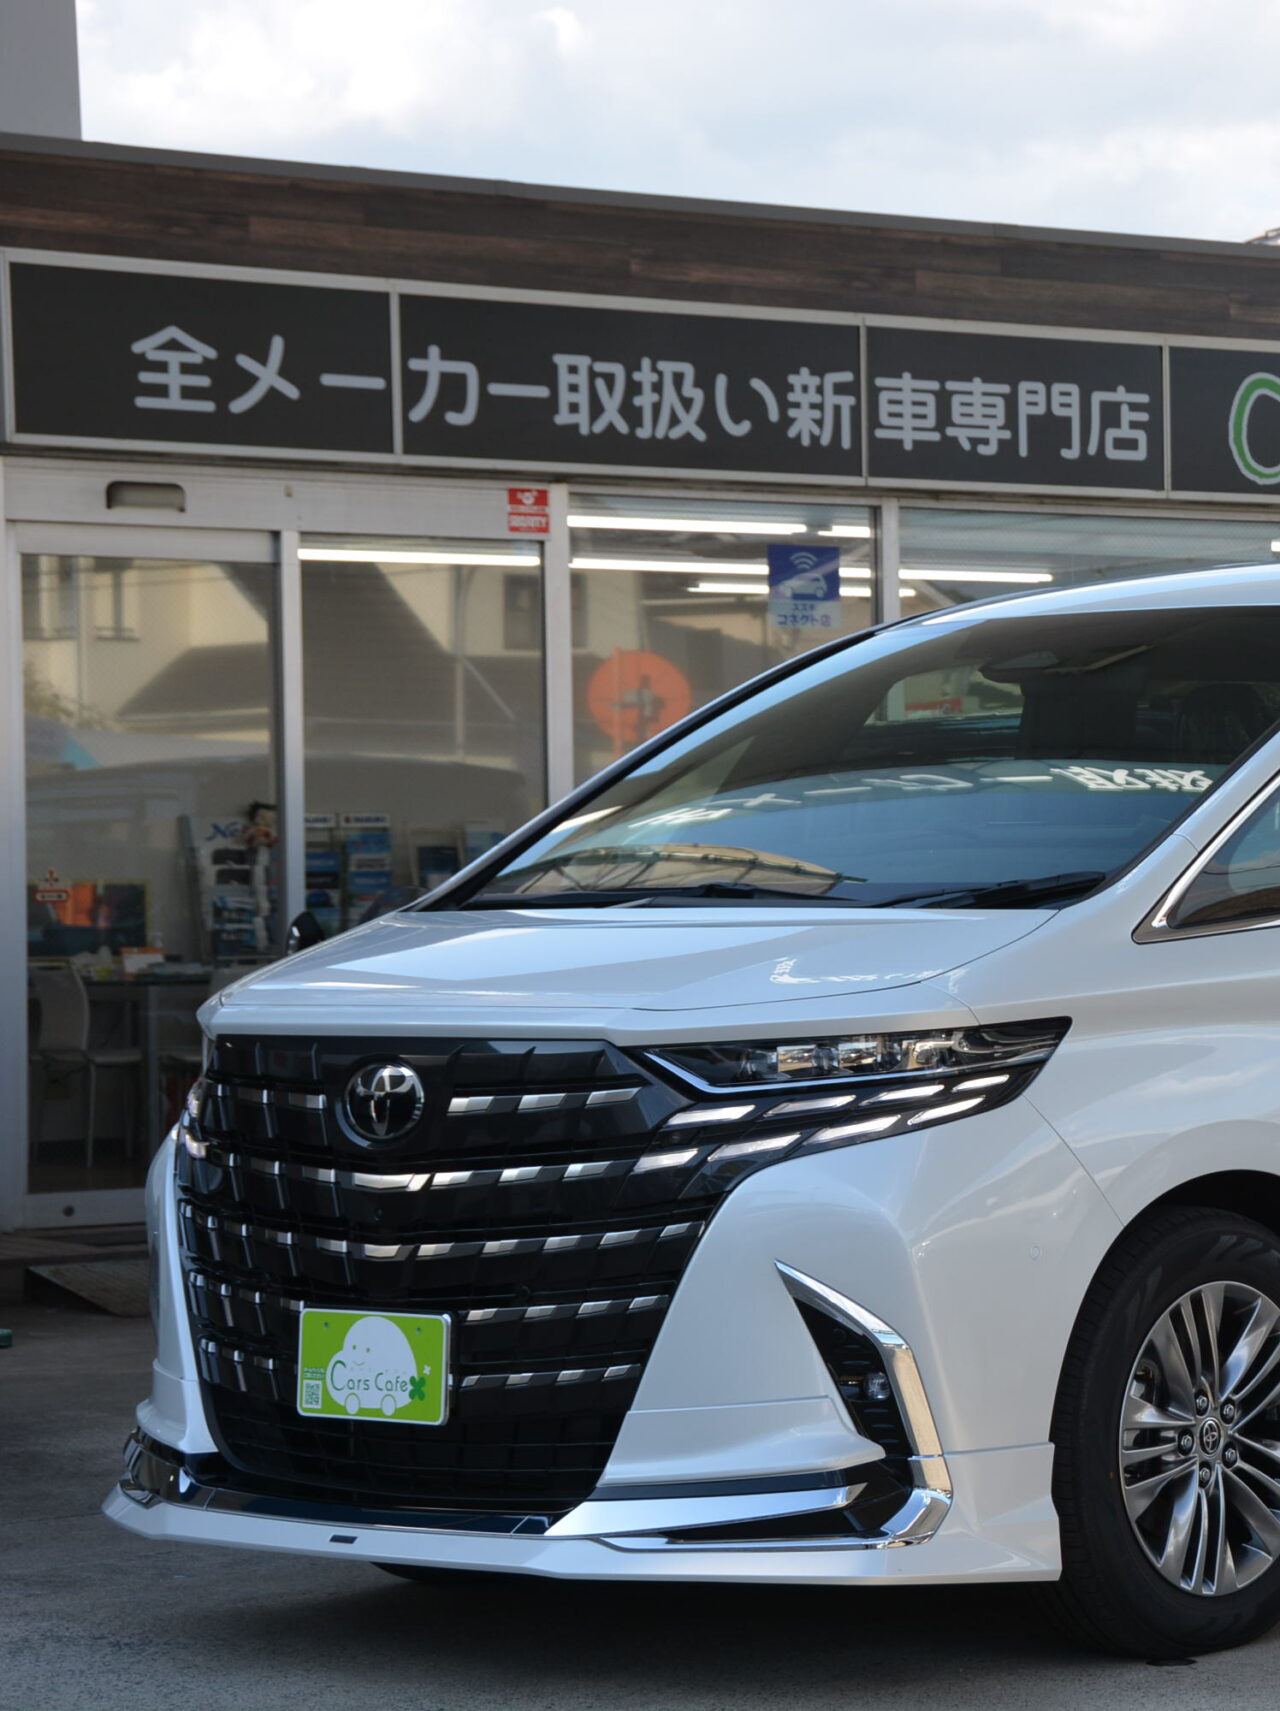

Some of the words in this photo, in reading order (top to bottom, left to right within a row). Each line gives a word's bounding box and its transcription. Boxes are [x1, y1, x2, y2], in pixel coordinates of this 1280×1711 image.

[131, 325, 1150, 461] 全メーカー取扱い新車専門店
[331, 1360, 371, 1391] Cars
[374, 1373, 409, 1393] Cafe
